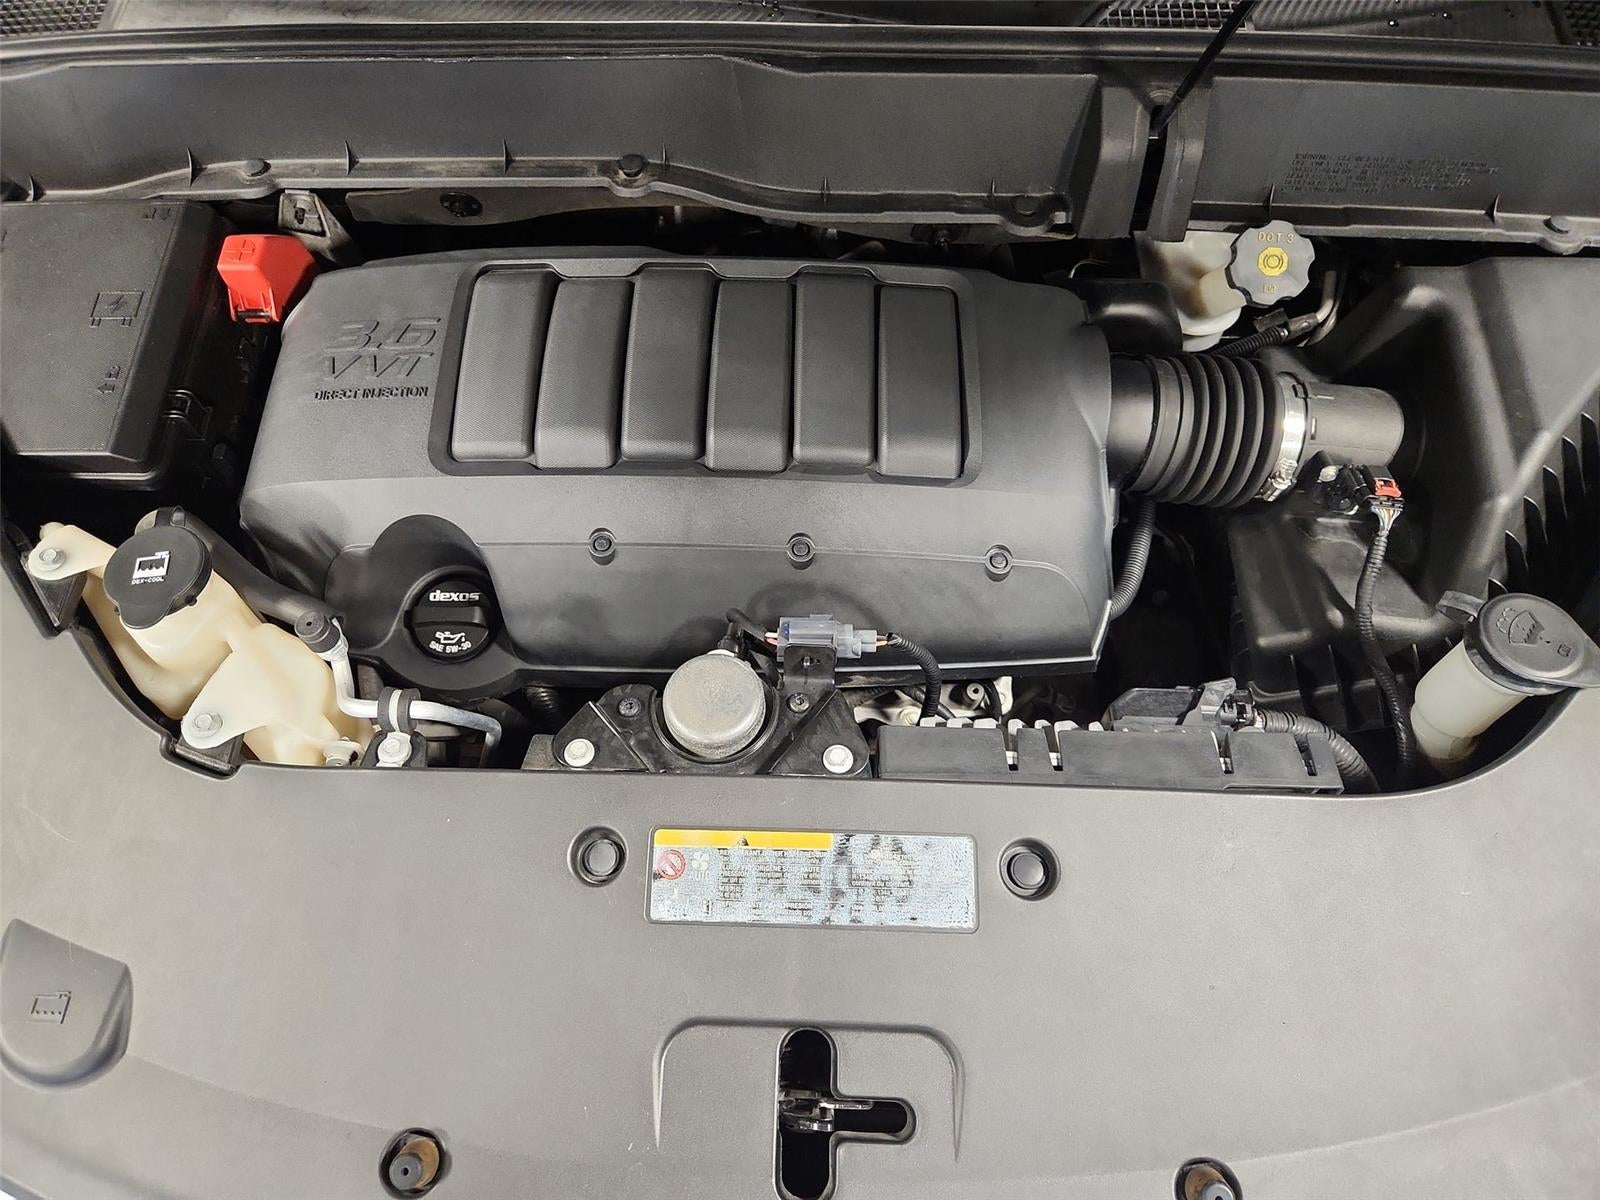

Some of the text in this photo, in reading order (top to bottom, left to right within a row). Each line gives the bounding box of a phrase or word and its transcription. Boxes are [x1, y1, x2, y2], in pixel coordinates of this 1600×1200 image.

[1258, 231, 1295, 244] DOT 3
[323, 317, 441, 351] 3.6
[323, 352, 434, 380] VVT
[314, 387, 429, 401] DIRECT INJECTION
[131, 577, 165, 585] DEX-COOL
[429, 590, 482, 602] dexos
[429, 640, 472, 654] SAE 5W-30
